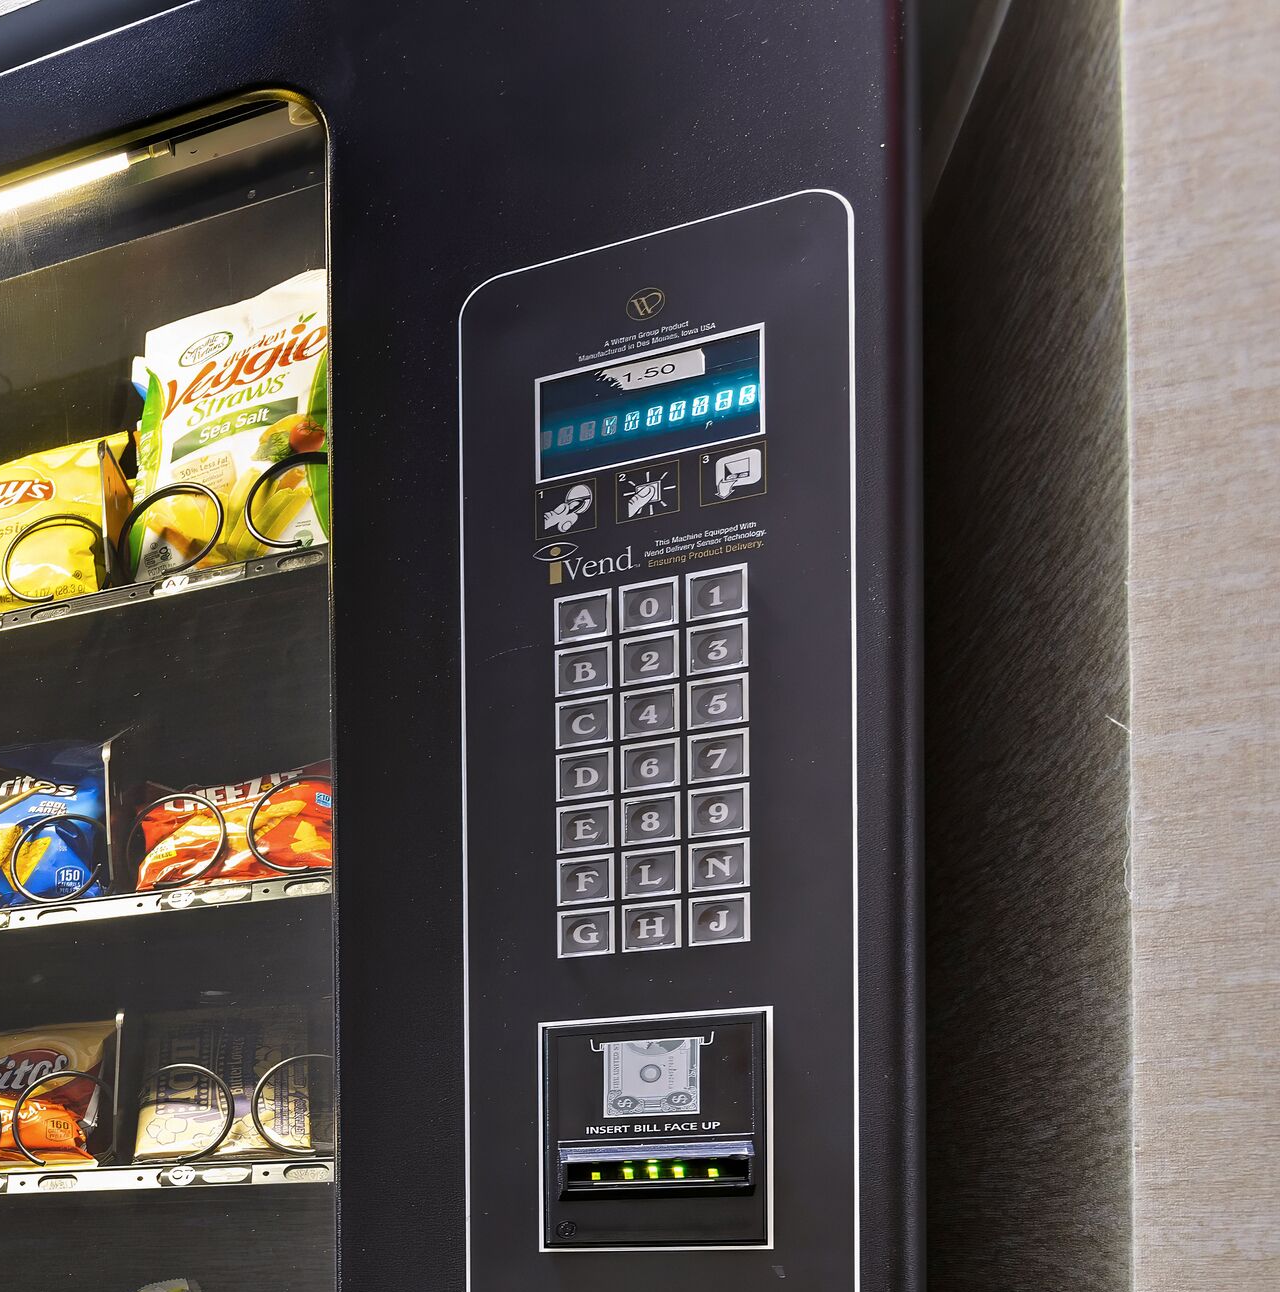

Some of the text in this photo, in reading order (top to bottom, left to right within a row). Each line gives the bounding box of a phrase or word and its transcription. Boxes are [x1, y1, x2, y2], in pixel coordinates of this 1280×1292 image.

[578, 343, 627, 362] Manufactured
[628, 342, 635, 351] in
[636, 339, 650, 348] Des
[681, 328, 699, 337] Iowa
[701, 322, 716, 332] USA
[638, 329, 659, 339] Group
[661, 320, 689, 332] Product
[224, 329, 287, 367] garden
[163, 324, 327, 420] Veggie
[622, 362, 676, 383] 1.50
[187, 376, 287, 427] Straws
[199, 408, 270, 444] Sea Salt
[199, 460, 216, 472] Less
[702, 455, 710, 464] 3
[619, 473, 627, 483] 2
[655, 521, 757, 547] This Machine Equipped With
[666, 543, 695, 554] Delivery
[697, 538, 721, 548] Sensor
[723, 529, 767, 543] Technology.
[648, 540, 765, 568] Ensuring Product Delivery.
[570, 586, 723, 631] A 0 1
[573, 639, 728, 683] B 2 3
[571, 693, 727, 734] C 4 5
[574, 749, 727, 787] D 6 7
[40, 801, 67, 809] COOL
[574, 802, 729, 840] E 8 9
[59, 869, 81, 882] 150
[576, 856, 732, 892] F L N
[572, 910, 729, 944] G H J
[50, 1119, 69, 1130] 160
[586, 1120, 720, 1135] INSERT BILL FACE UP
